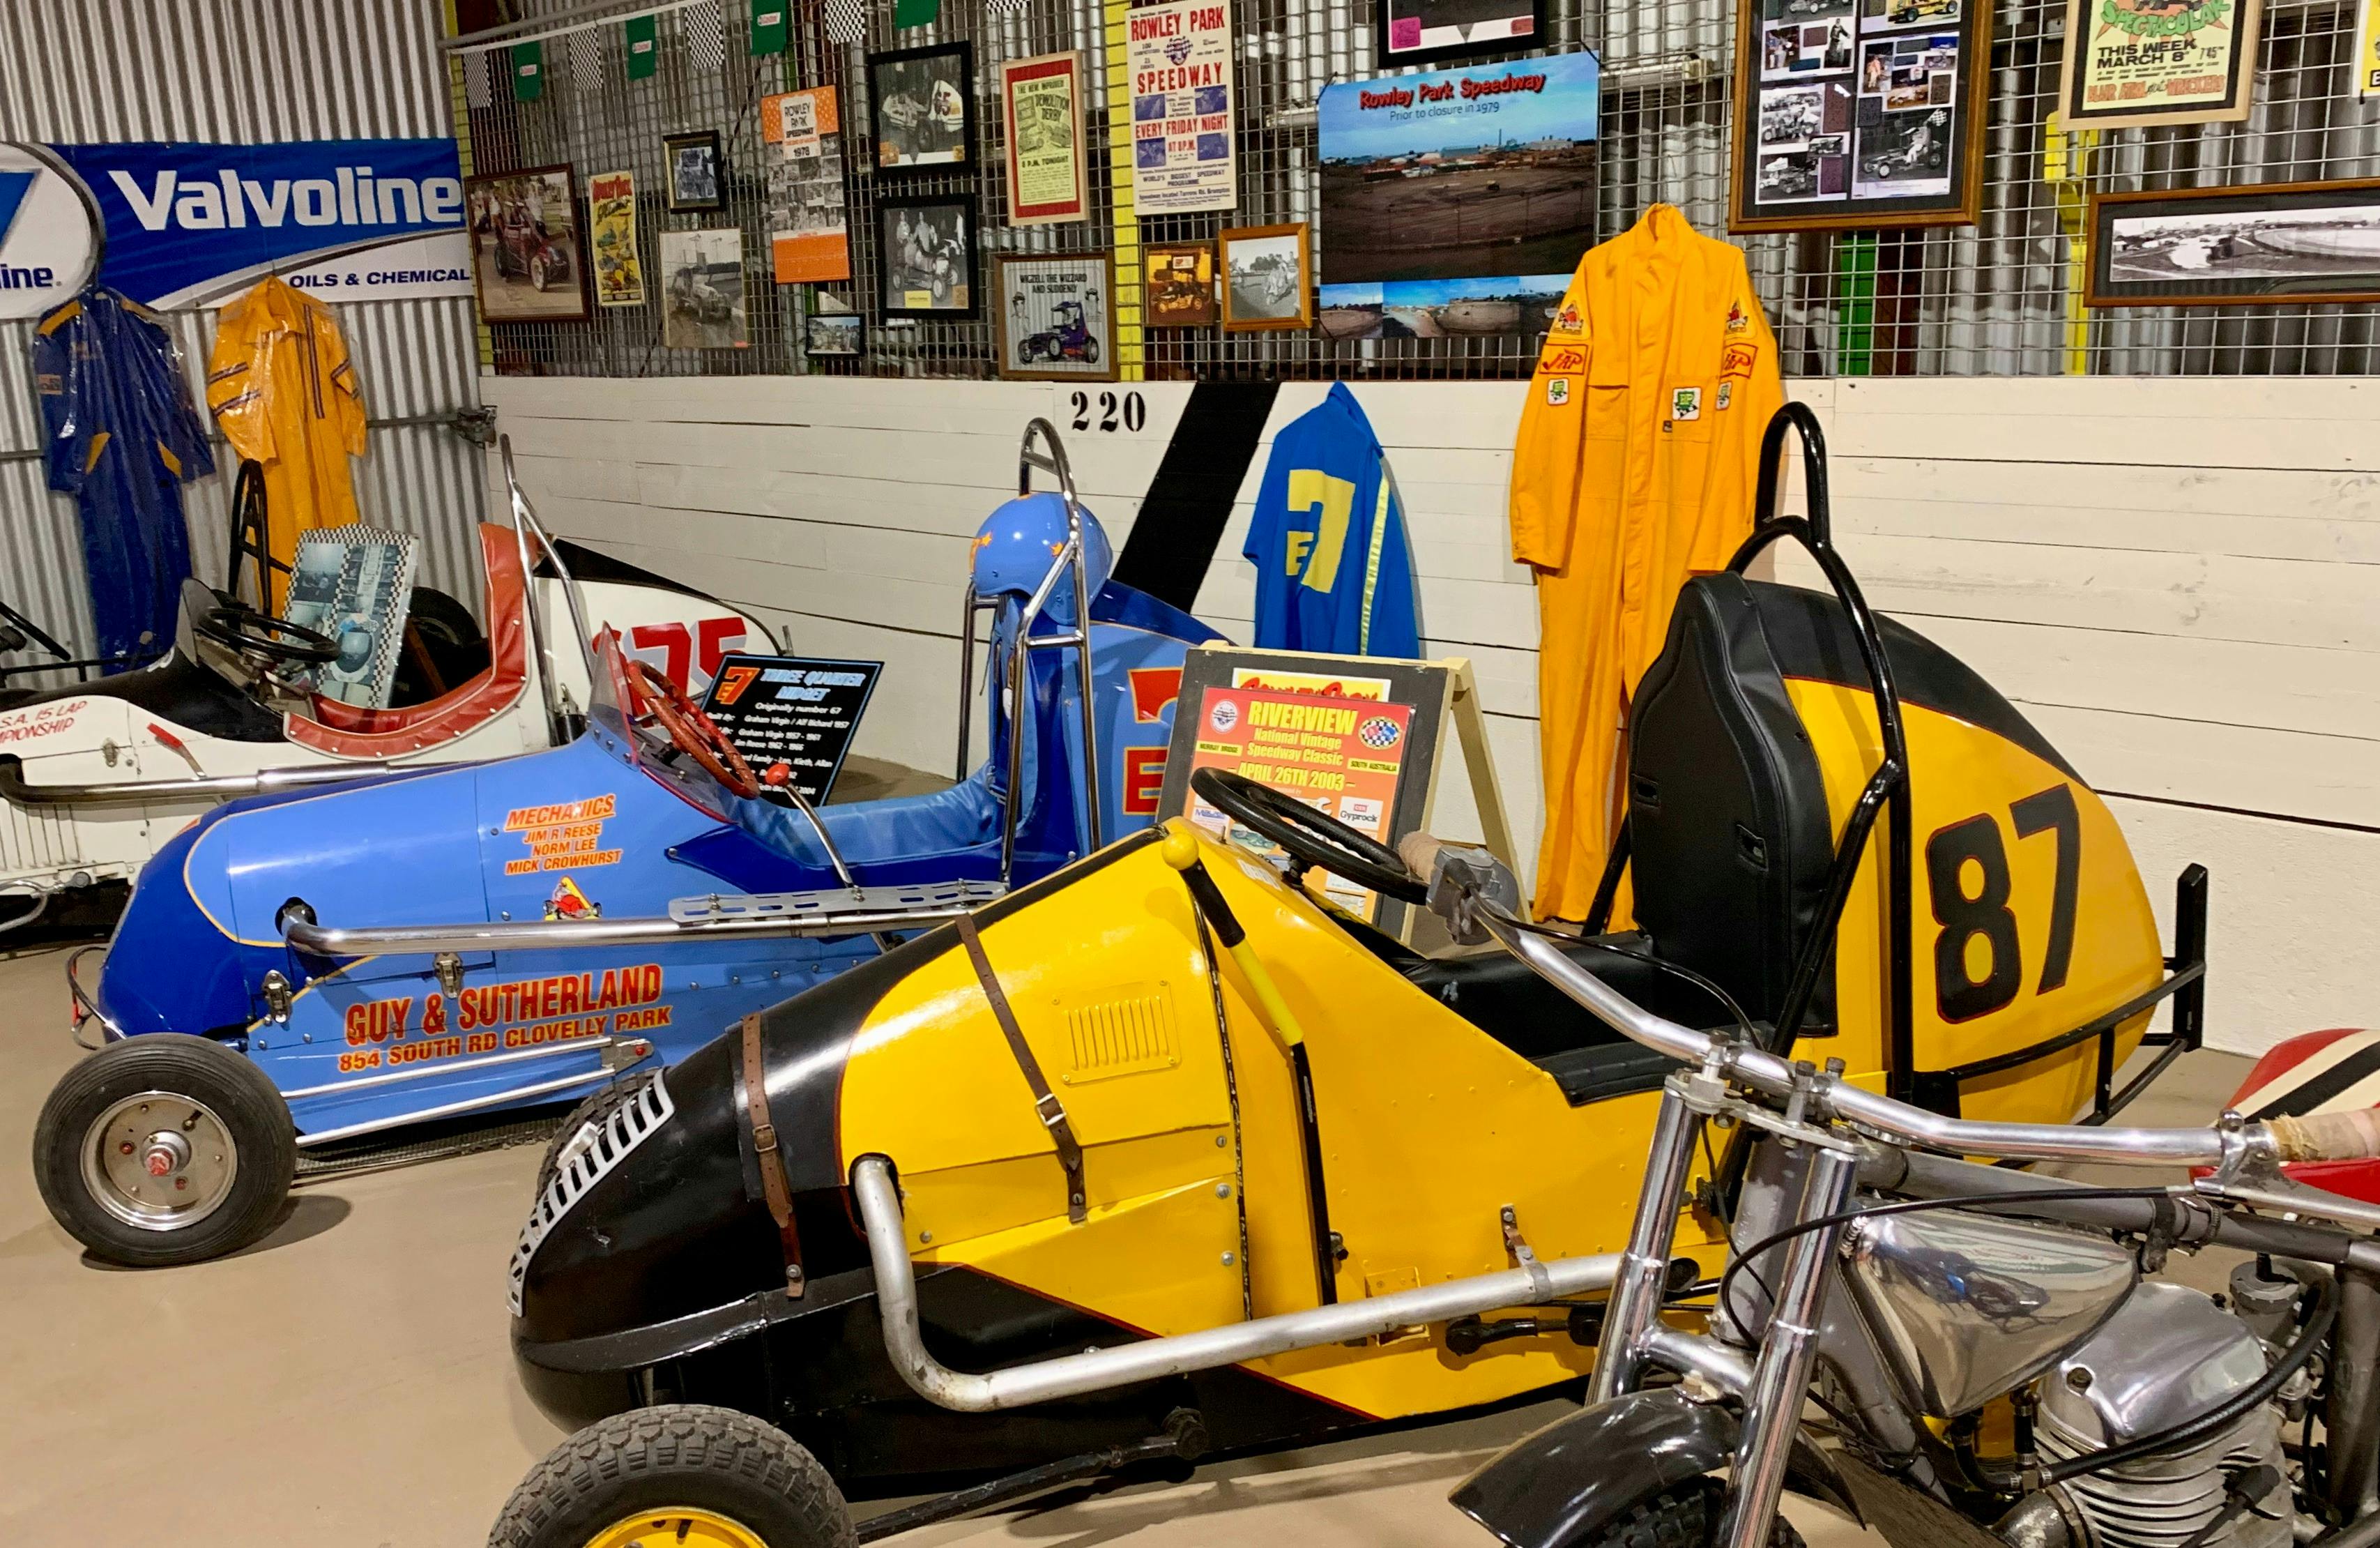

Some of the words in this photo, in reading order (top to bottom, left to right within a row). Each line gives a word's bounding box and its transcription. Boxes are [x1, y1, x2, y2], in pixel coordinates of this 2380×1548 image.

[1131, 13, 1181, 41] ROWLEY
[1190, 6, 1225, 32] PARK
[2100, 0, 2231, 38] SPECTACULAR
[2098, 44, 2139, 57] THIS
[2143, 38, 2197, 54] WEEK
[2097, 53, 2164, 68] MARCH
[1138, 62, 1222, 94] SPEEDWAY
[1359, 88, 1413, 110] Rowley
[1419, 81, 1454, 103] Park
[1460, 73, 1546, 100] Speedway
[784, 103, 811, 117] ROWLEY
[1390, 110, 1412, 121] Prior
[1415, 109, 1426, 119] to
[1428, 105, 1463, 117] closure
[1465, 103, 1474, 113] in
[1477, 102, 1500, 114] 1979
[1136, 123, 1162, 139] EVERY
[1166, 118, 1198, 135] FRIDAY
[1202, 114, 1228, 131] NIGHT
[1168, 142, 1176, 152] AT
[108, 166, 463, 231] Valvoline
[0, 264, 53, 289] ine
[289, 274, 338, 288] OILS
[345, 273, 360, 286] &
[367, 268, 470, 284] CHEMICAL
[1032, 284, 1045, 293] AND
[1046, 274, 1058, 283] THE
[1059, 273, 1088, 282] WIZZARD
[1071, 390, 1145, 432] 220
[1287, 469, 1356, 594] 7
[1286, 531, 1314, 576] E
[720, 666, 761, 705] 7
[803, 671, 867, 687] QUARTER
[36, 707, 54, 720] 15
[56, 700, 88, 716] LAP
[744, 715, 770, 723] Graham
[755, 702, 794, 713] Originally
[795, 705, 829, 714] number
[1247, 700, 1359, 736] RIVERVIEW
[738, 728, 764, 737] Graham
[1254, 727, 1299, 745] National
[1300, 732, 1342, 751] Vintage
[1247, 741, 1302, 761] Speedway
[1302, 748, 1343, 766] Classic
[1238, 761, 1273, 782] APRIL
[1274, 766, 1309, 786] 26TH
[1309, 771, 1345, 791] 2003
[1368, 762, 1397, 772] AUSTRALIA
[505, 794, 615, 828] MECHANICS
[1340, 810, 1378, 823] Gyprock
[524, 829, 547, 843] JIM
[551, 828, 560, 840] R
[564, 824, 601, 838] REESE
[533, 840, 570, 856] NORM
[574, 839, 596, 851] LEE
[505, 860, 539, 874] MICK
[544, 850, 623, 870] CROWHURST
[1925, 782, 2081, 1024] 87
[346, 996, 411, 1047] GUY
[424, 992, 446, 1033] &
[458, 963, 664, 1030] SUTHERLAND
[339, 1049, 381, 1072] 854
[389, 1037, 460, 1064] SOUTH
[468, 1031, 498, 1054] RD
[505, 1017, 606, 1048] CLOVELLY
[615, 1006, 673, 1033] PARK
